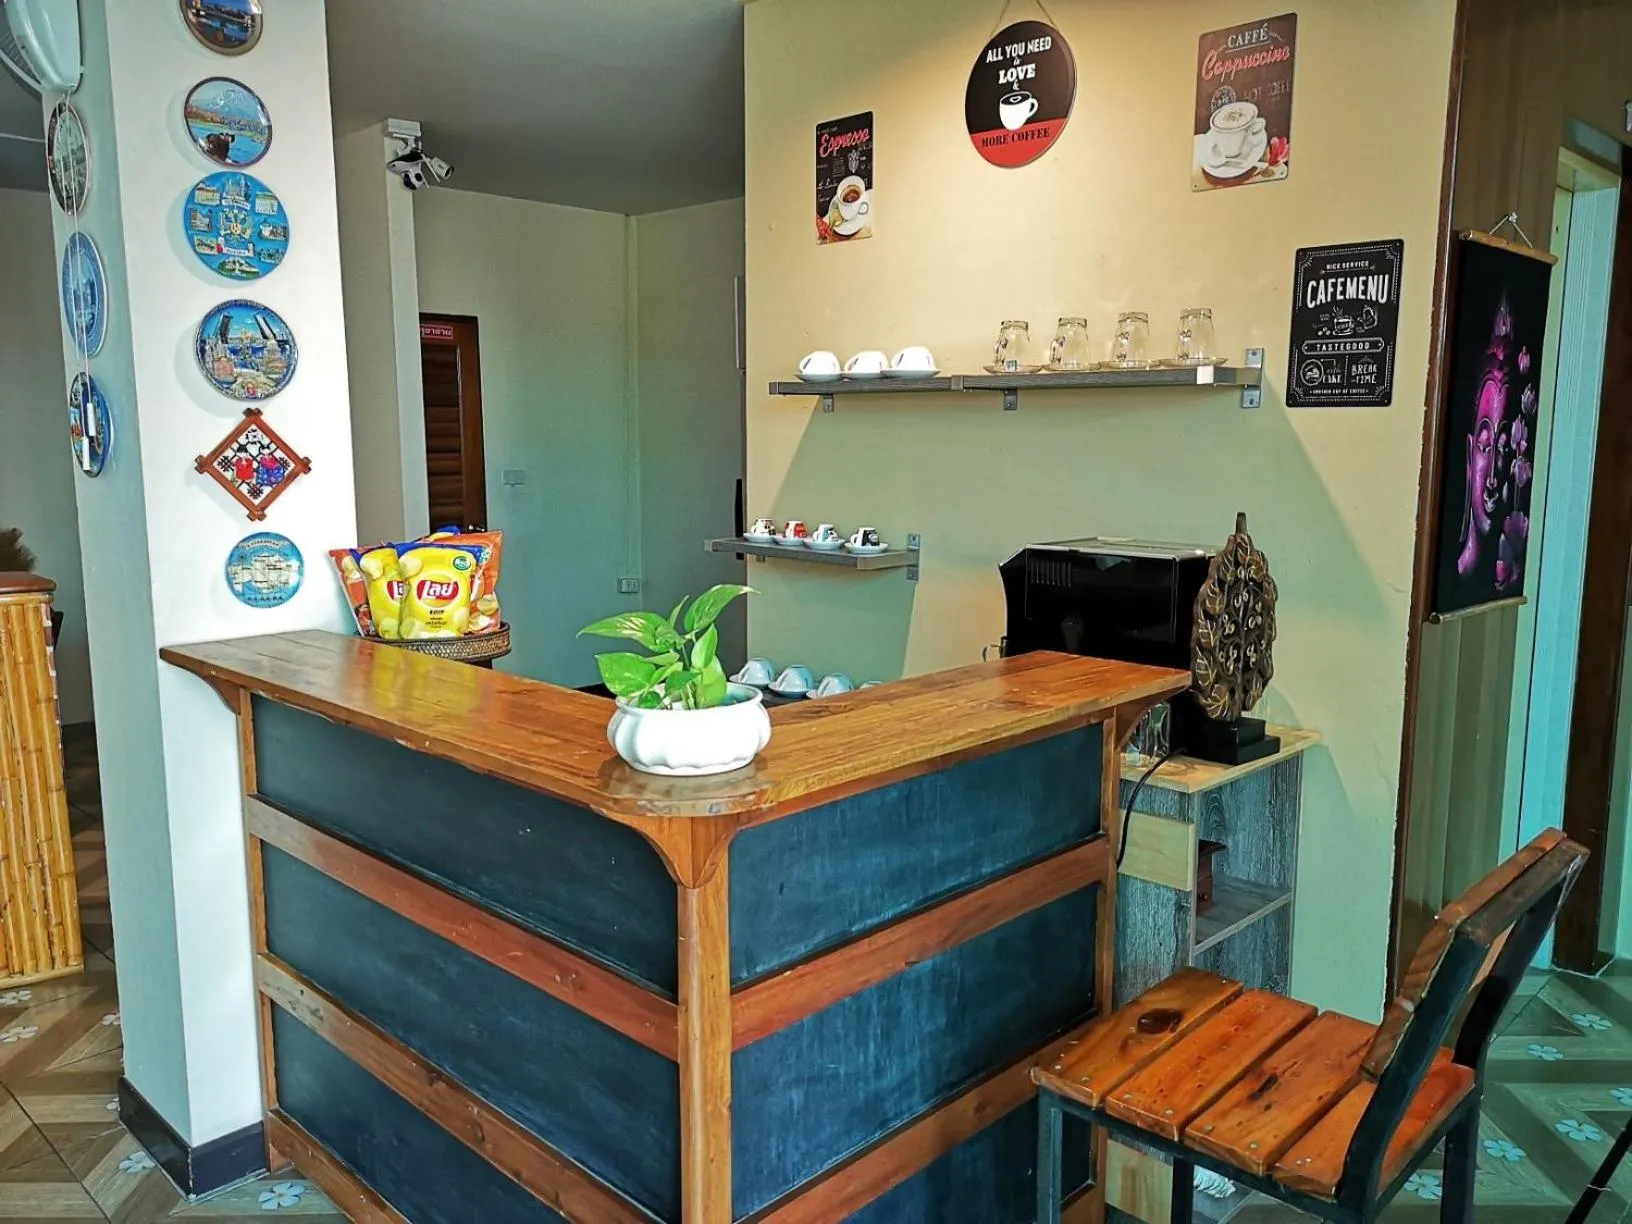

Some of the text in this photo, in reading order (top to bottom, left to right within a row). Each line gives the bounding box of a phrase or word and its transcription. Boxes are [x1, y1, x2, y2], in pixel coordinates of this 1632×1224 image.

[1227, 23, 1268, 48] CAFFÉ
[986, 36, 1052, 63] ALL YOU NEED
[998, 63, 1036, 85] LOVE
[1202, 45, 1290, 83] Cappuccino
[818, 127, 871, 158] Espresso
[981, 127, 1050, 148] MORE COFFEE
[1326, 260, 1369, 270] NICE SERVICE
[1306, 273, 1390, 309] CAFEMENU
[1316, 341, 1370, 352] TASTEGOOD
[1351, 363, 1377, 376] BREAK
